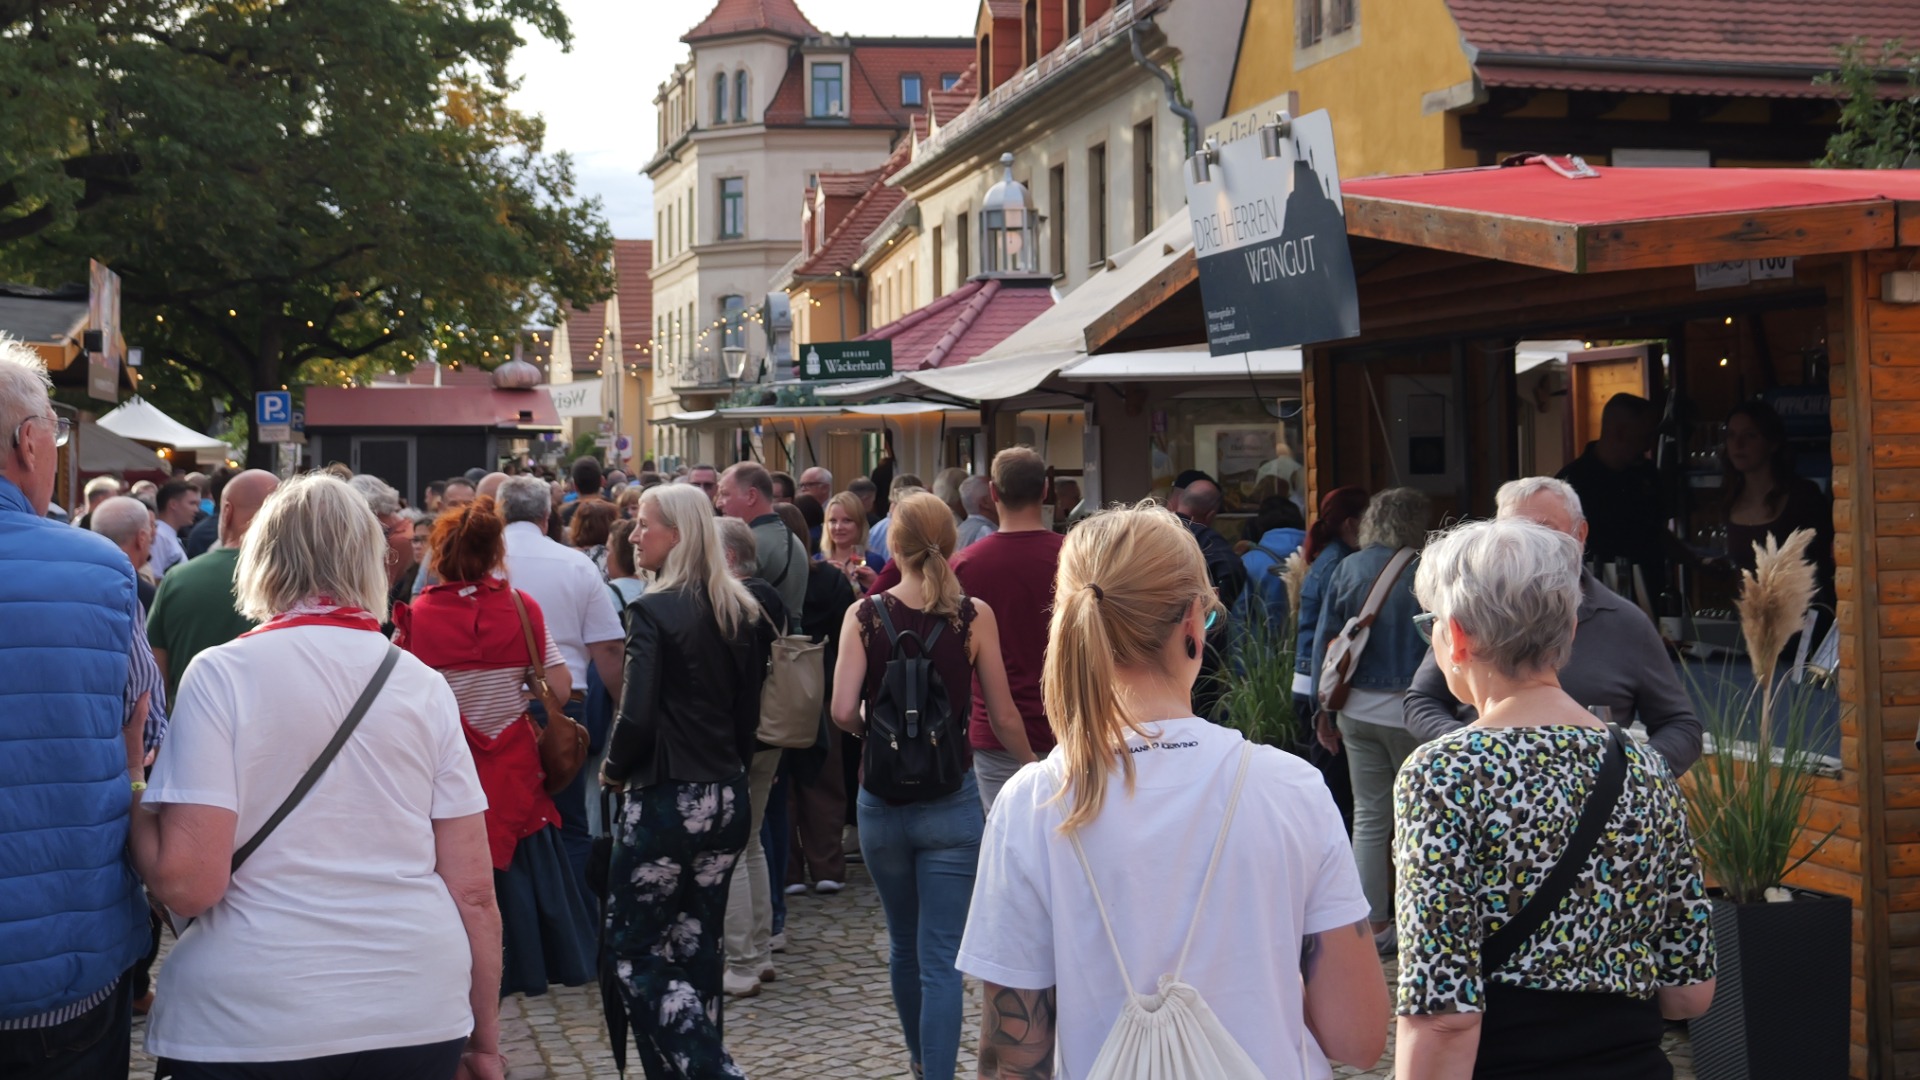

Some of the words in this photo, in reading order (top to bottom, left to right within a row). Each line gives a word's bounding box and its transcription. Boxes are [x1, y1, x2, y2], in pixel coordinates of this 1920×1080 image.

[1194, 213, 1223, 252] DREI
[1223, 195, 1279, 243] HERREN
[1244, 235, 1315, 284] WEINGUT
[824, 359, 886, 374] Wackerbarth
[264, 396, 283, 421] P
